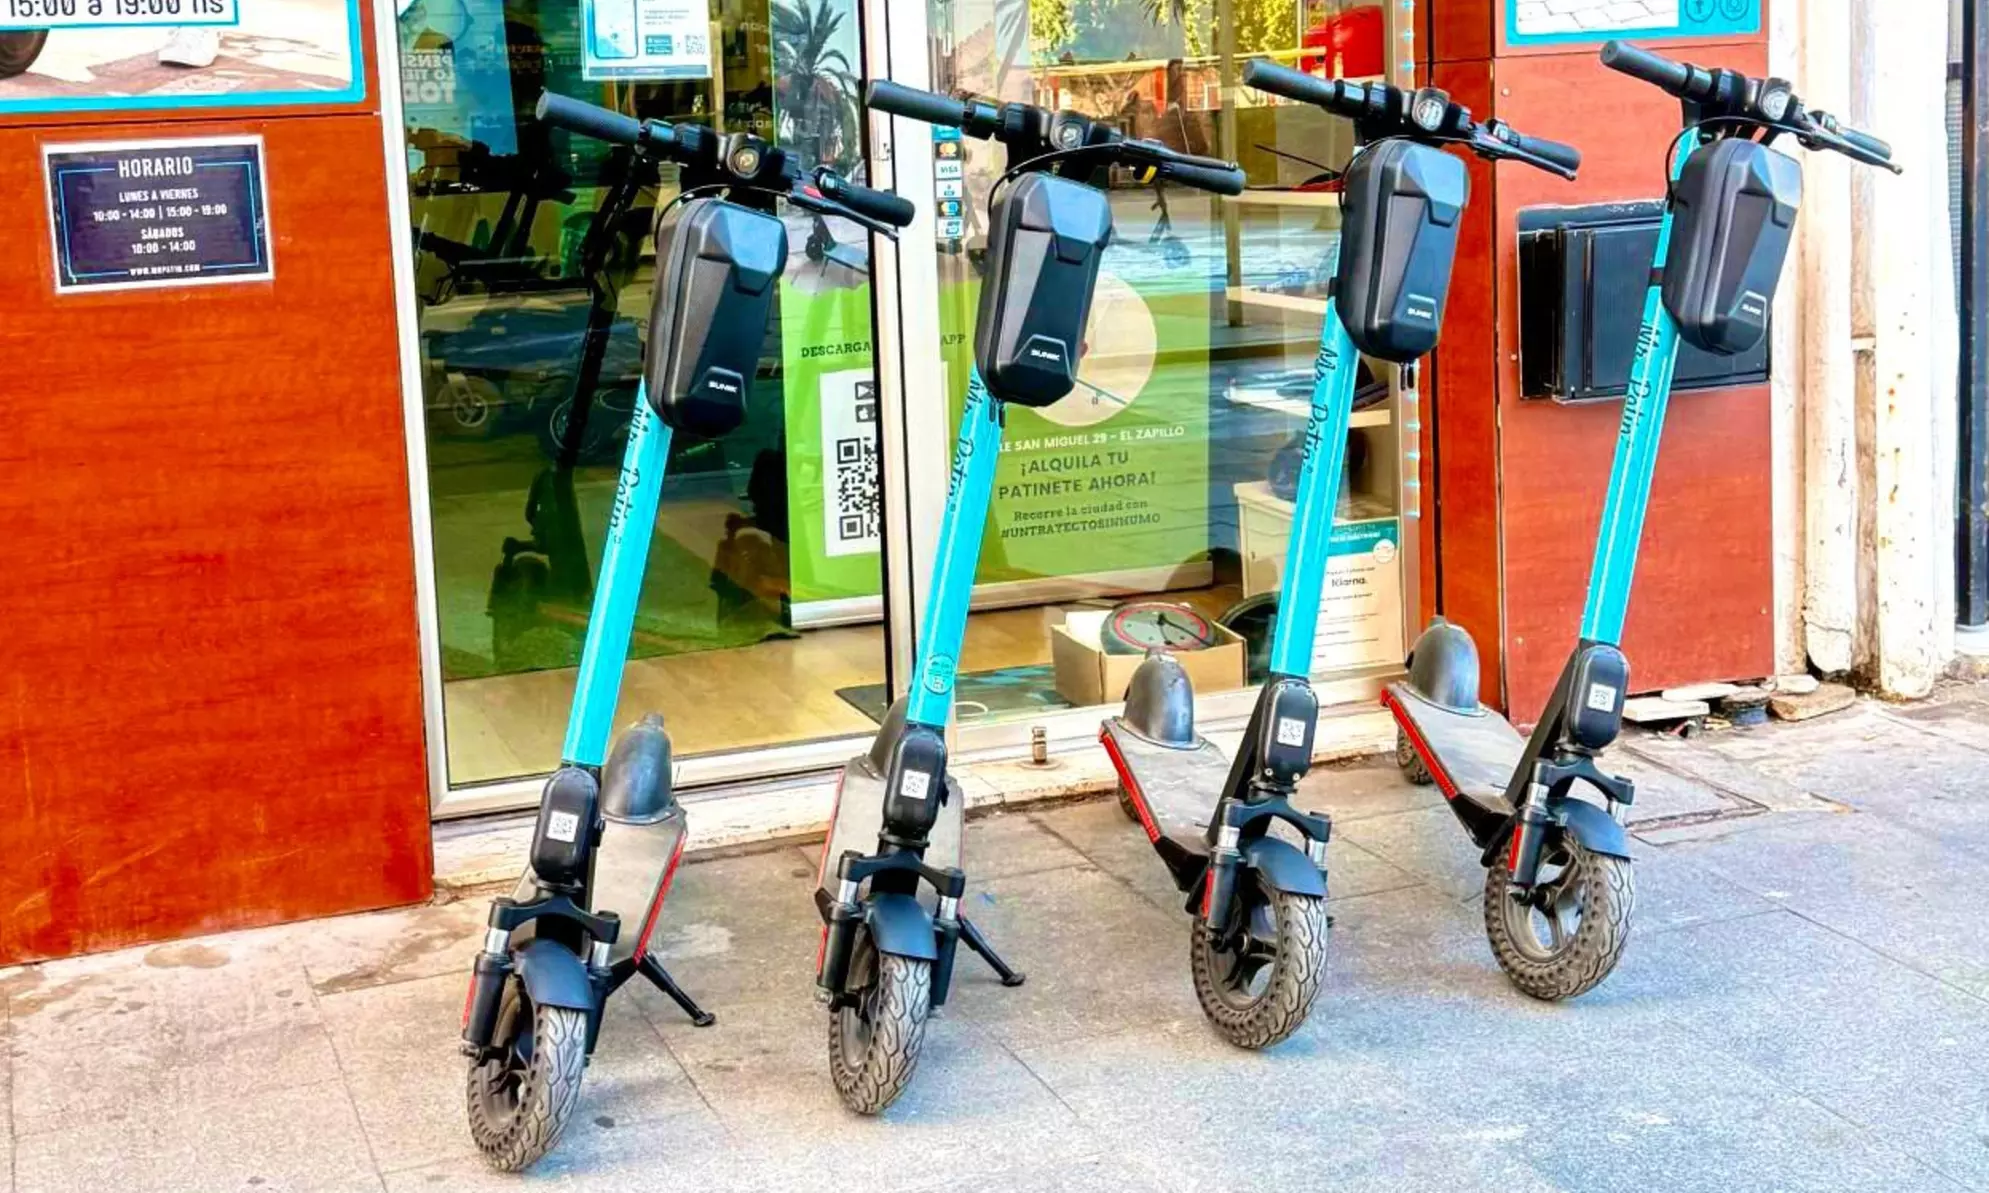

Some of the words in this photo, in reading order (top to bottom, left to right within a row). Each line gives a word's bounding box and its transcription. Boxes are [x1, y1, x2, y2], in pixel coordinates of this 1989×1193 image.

[88, 0, 101, 17] a
[119, 156, 194, 178] HORARIO
[119, 190, 149, 203] LUNES
[151, 189, 159, 201] A
[160, 188, 199, 201] VIERNES
[93, 210, 120, 222] 10:00
[128, 207, 156, 219] 14:00
[166, 205, 192, 217] 15:00
[201, 203, 227, 216] 19:00
[132, 242, 159, 254] 10:00
[169, 239, 196, 252] 14:00
[801, 341, 871, 358] DESCARGA
[940, 333, 966, 347] APP
[1015, 438, 1041, 452] SAN
[1044, 434, 1090, 449] MIGUEL
[1119, 429, 1134, 442] EL
[1135, 426, 1185, 439] ZAPILLO
[1020, 453, 1102, 477] ¡ALQUILA
[1107, 451, 1129, 466] TU
[999, 478, 1082, 500] PATINETE
[1088, 471, 1157, 492] AHORA!
[1014, 506, 1064, 522] Recorre
[1066, 504, 1078, 517] la
[1080, 500, 1124, 516] ciudad
[1125, 500, 1149, 512] con
[1001, 512, 1161, 539] #UNTRAYECTOSINHUMO
